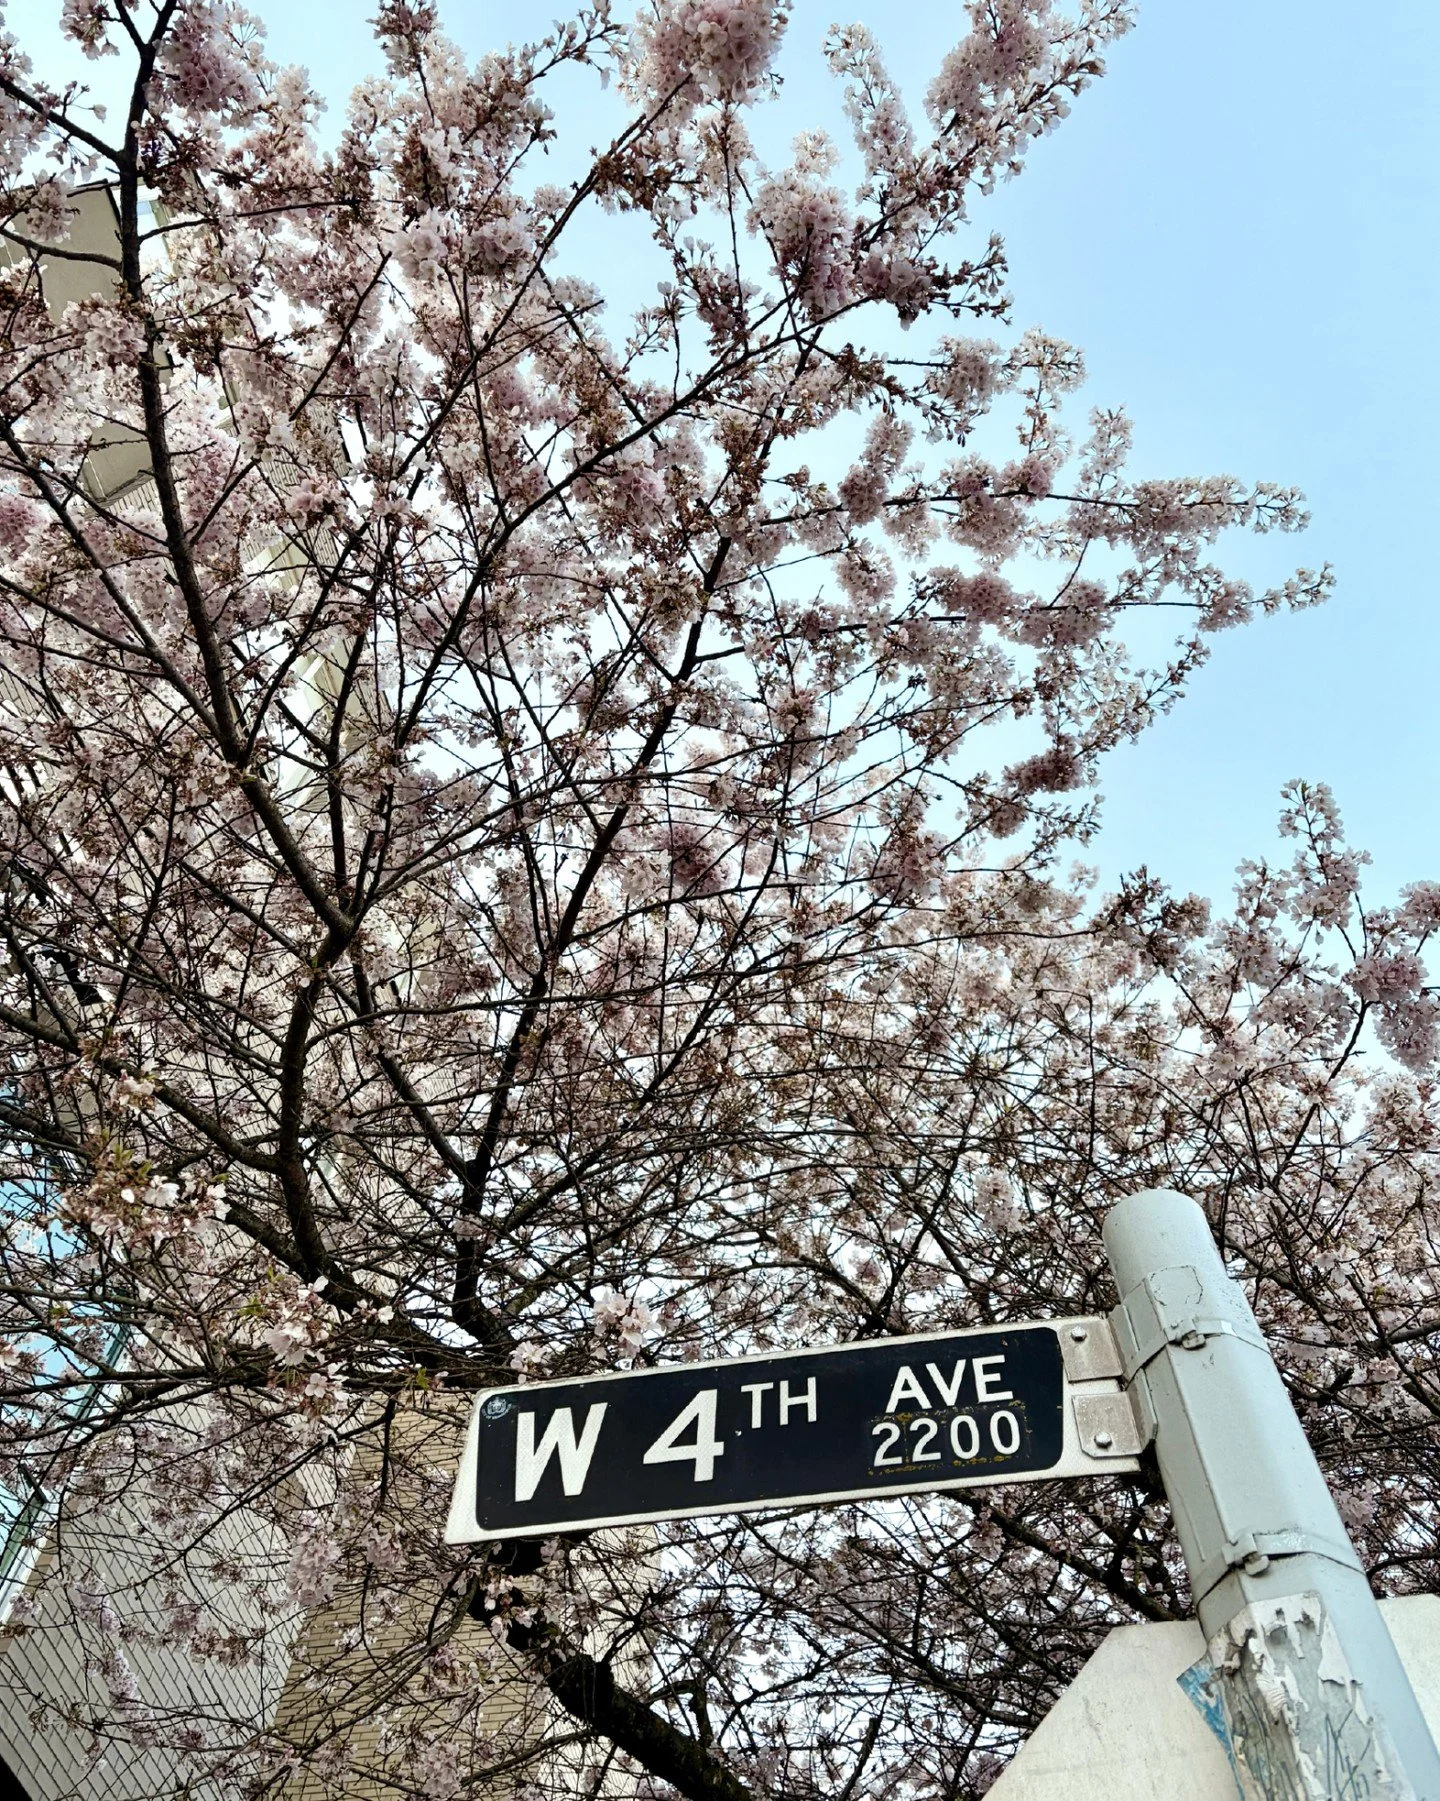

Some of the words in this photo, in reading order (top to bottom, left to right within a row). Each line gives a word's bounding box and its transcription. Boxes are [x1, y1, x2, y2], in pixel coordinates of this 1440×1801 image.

[515, 1402, 609, 1503] W
[886, 1355, 1014, 1413] AVE
[872, 1410, 1021, 1467] 2200
